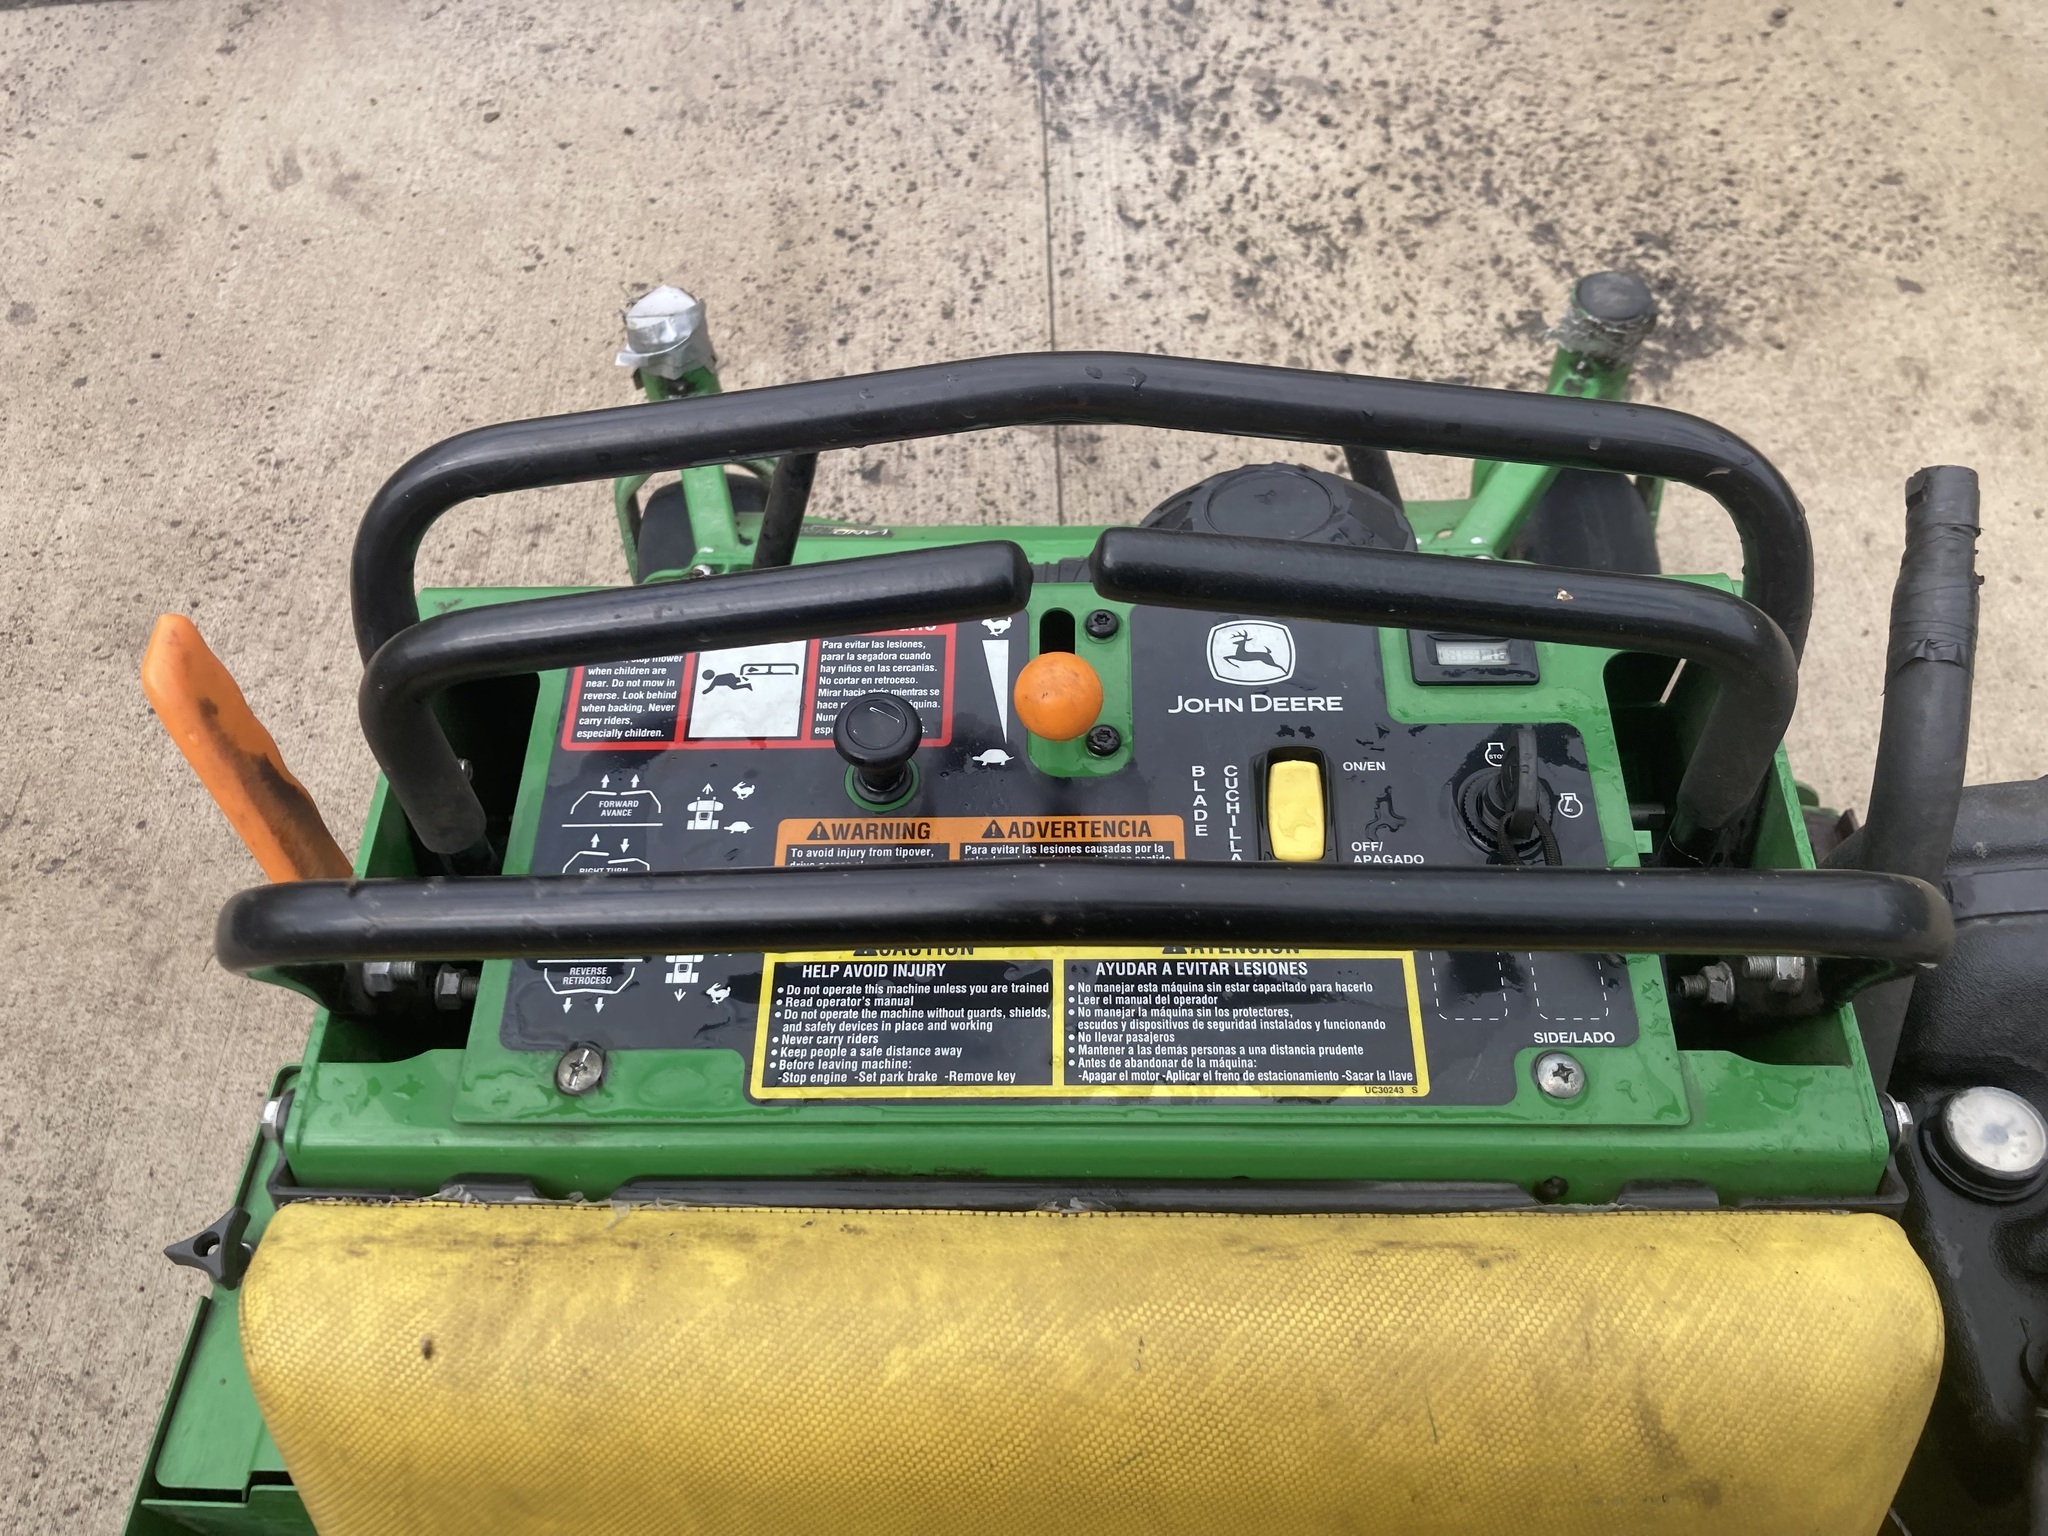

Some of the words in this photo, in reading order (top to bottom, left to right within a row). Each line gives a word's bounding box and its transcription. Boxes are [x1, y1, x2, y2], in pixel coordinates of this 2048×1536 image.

[822, 641, 843, 649] Para
[844, 641, 870, 649] evitar
[871, 640, 885, 649] las
[887, 640, 926, 649] lesiones,
[821, 654, 845, 662] parar
[857, 652, 897, 662] segadora
[899, 652, 931, 660] cuando
[588, 667, 612, 675] when
[614, 666, 650, 675] children
[820, 664, 836, 675] hay
[838, 664, 862, 673] niños
[877, 664, 891, 672] las
[626, 679, 641, 687] not
[833, 677, 860, 685] cortar
[874, 676, 918, 684] retroceso.
[622, 691, 645, 700] Look
[646, 690, 677, 699] behind
[818, 688, 842, 697] Mirar
[843, 688, 866, 697] hacia
[891, 688, 928, 696] mientras
[582, 704, 606, 713] when
[608, 703, 645, 714] backing.
[648, 703, 676, 712] Never
[1168, 695, 1243, 714] JOHN
[1250, 694, 1343, 712] DEERE
[579, 718, 603, 727] carry
[577, 729, 623, 739] especially
[624, 728, 664, 737] children.
[1342, 761, 1386, 772] ON/EN
[598, 800, 640, 808] FORWARD
[1191, 765, 1208, 837] BLADE
[600, 809, 633, 817] AVANCE
[832, 822, 931, 840] WARNING
[1008, 820, 1152, 838] ADVERTENCIA
[965, 845, 987, 855] Para
[991, 845, 1019, 854] evitar
[1022, 845, 1037, 854] las
[1040, 844, 1082, 854] lesiones
[1085, 844, 1132, 854] causadas
[1135, 845, 1152, 855] por
[1351, 841, 1383, 852] OFF/
[806, 848, 834, 857] avoid
[837, 848, 866, 859] injury
[869, 848, 892, 857] from
[895, 847, 934, 859] tipover,
[1353, 854, 1425, 865] APAGADO
[569, 966, 608, 976] REVERSE
[802, 965, 840, 978] HELP
[843, 964, 888, 978] AVOID
[893, 963, 946, 977] INJURY
[1096, 962, 1157, 976] AYUDAR
[1177, 962, 1230, 975] EVITAR
[1235, 962, 1308, 976] LESIONES
[562, 976, 613, 985] RETROCESO
[804, 986, 820, 995] not
[823, 985, 862, 997] operate
[865, 985, 884, 994] this
[887, 985, 931, 994] machine
[934, 984, 967, 994] unless
[969, 985, 988, 996] you
[991, 985, 1008, 993] are
[1011, 984, 1049, 993] trained
[1094, 982, 1135, 995] manejar
[1138, 982, 1158, 993] esta
[1161, 982, 1204, 995] máquina
[1207, 982, 1222, 992] sin
[1225, 982, 1250, 992] estar
[1253, 982, 1307, 994] capacitado
[1310, 984, 1332, 994] para
[1335, 982, 1373, 992] hacerlo
[785, 998, 813, 1007] Read
[816, 997, 871, 1009] operator's
[874, 996, 914, 1006] manual
[1078, 995, 1100, 1005] Leer
[1115, 995, 1152, 1005] manual
[1155, 995, 1170, 1005] del
[1174, 995, 1218, 1007] operador
[801, 1010, 817, 1019] not
[820, 1010, 859, 1021] operate
[861, 1010, 877, 1019] the
[880, 1009, 924, 1019] machine
[927, 1009, 965, 1018] without
[967, 1009, 1006, 1020] guards,
[1009, 1008, 1050, 1019] shields,
[1094, 1008, 1136, 1019] manejar
[1151, 1008, 1194, 1020] máquina
[1196, 1008, 1212, 1017] sin
[1215, 1008, 1230, 1017] los
[1233, 1008, 1293, 1019] protectores,
[783, 1022, 802, 1032] and
[805, 1022, 836, 1034] safety
[839, 1022, 879, 1032] devices
[895, 1022, 924, 1033] place
[927, 1021, 947, 1031] and
[950, 1021, 993, 1033] working
[1078, 1020, 1118, 1030] escudos
[1130, 1020, 1189, 1032] dispositivos
[1207, 1020, 1257, 1032] seguridad
[1260, 1020, 1312, 1030] instalados
[1323, 1020, 1386, 1030] funcionando
[782, 1035, 814, 1045] Never
[816, 1036, 844, 1047] carry
[847, 1034, 879, 1044] riders
[1095, 1033, 1123, 1042] llevar
[1126, 1032, 1175, 1045] pasajeros
[1533, 1031, 1616, 1044] SIDE/LADO
[780, 1048, 807, 1059] Keep
[810, 1047, 847, 1059] people
[860, 1047, 883, 1057] safe
[886, 1047, 931, 1056] distance
[934, 1047, 963, 1058] away
[1078, 1045, 1126, 1055] Mantener
[1137, 1045, 1152, 1055] las
[1155, 1045, 1188, 1055] demás
[1191, 1046, 1236, 1057] personas
[1248, 1046, 1267, 1055] una
[1270, 1045, 1316, 1055] distancia
[1319, 1045, 1364, 1057] prudente
[779, 1060, 814, 1070] Before
[818, 1060, 858, 1072] leaving
[862, 1060, 912, 1069] machine:
[1078, 1058, 1106, 1068] Antes
[1125, 1058, 1178, 1068] abandonar
[1209, 1058, 1257, 1070] máquina:
[778, 1073, 807, 1085] -Stop
[810, 1073, 847, 1085] engine
[854, 1073, 877, 1083] -Set
[880, 1073, 904, 1085] park
[907, 1072, 938, 1082] brake
[945, 1072, 994, 1082] -Remove
[997, 1072, 1016, 1084] key
[1078, 1072, 1117, 1083] -Apagar
[1131, 1072, 1160, 1081] motor
[1162, 1072, 1200, 1083] -Aplicar
[1215, 1072, 1240, 1081] freno
[1258, 1072, 1339, 1081] estacionamiento
[1342, 1072, 1374, 1081] -Sacar
[1389, 1072, 1413, 1081] llave
[1364, 1086, 1404, 1094] UC30243
